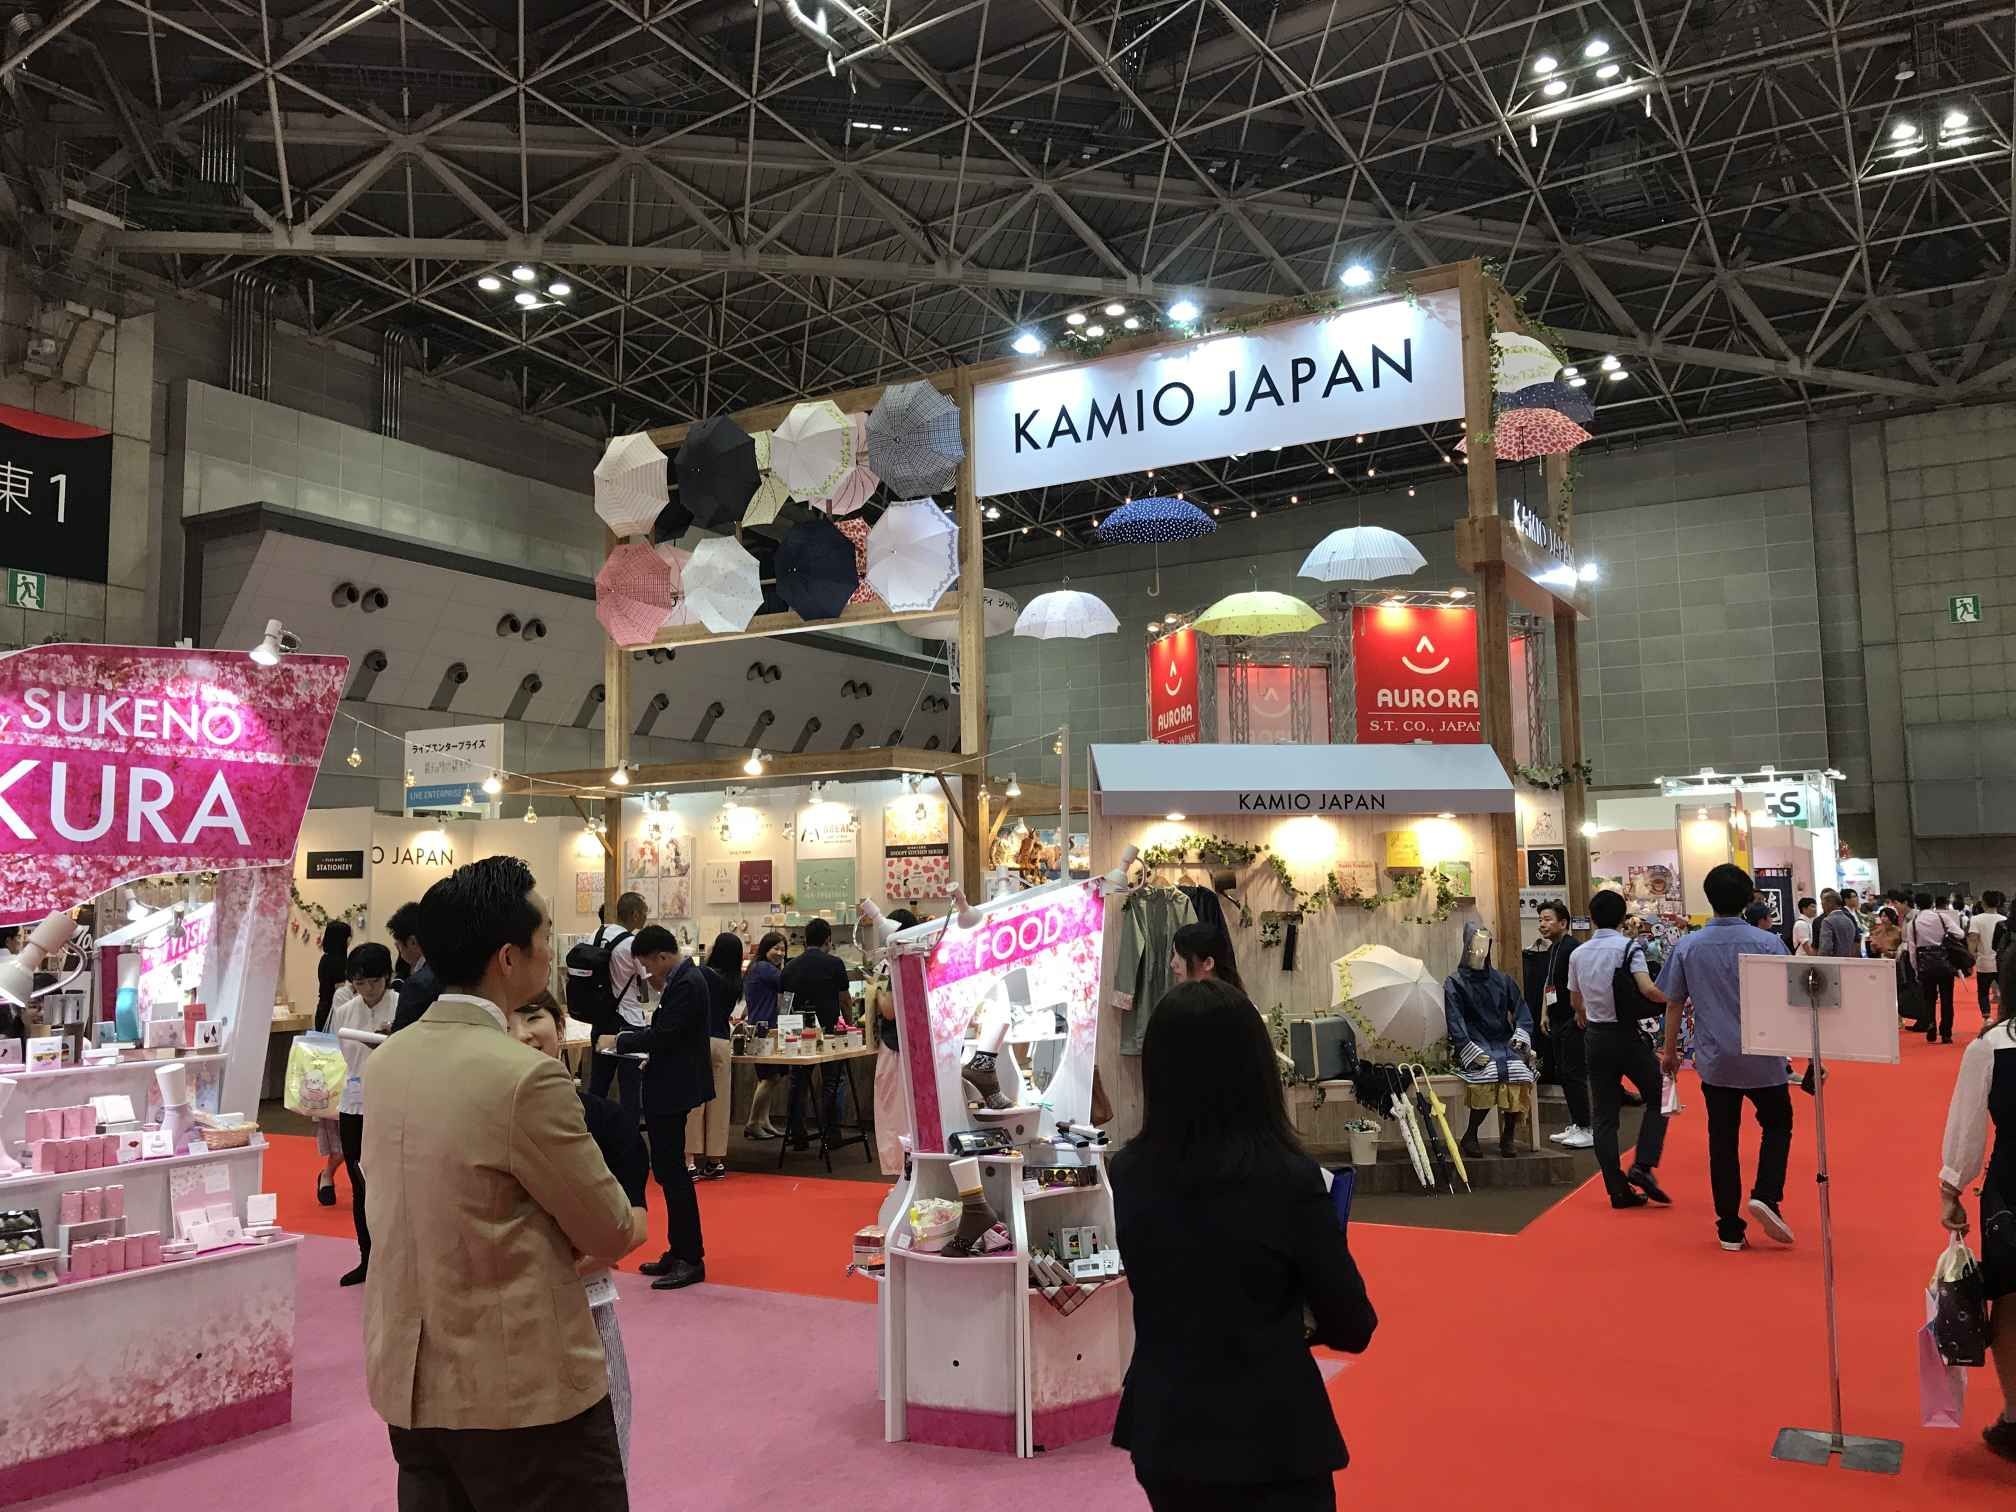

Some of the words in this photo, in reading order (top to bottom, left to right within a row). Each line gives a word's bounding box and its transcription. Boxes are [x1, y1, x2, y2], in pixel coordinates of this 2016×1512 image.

[1014, 381, 1194, 454] KAMIO
[1219, 338, 1413, 416] JAPAN
[1513, 499, 1547, 548] KAMIO
[1377, 688, 1479, 708] AURORA
[22, 687, 242, 745] SUKENO
[1157, 704, 1192, 731] AURORA
[1369, 720, 1398, 732] S.T.
[1403, 720, 1434, 733] CO.,
[0, 759, 251, 847] KURA
[1239, 793, 1311, 810] KAMIO
[1319, 793, 1385, 810] JAPAN
[316, 863, 353, 872] STATIONERY
[392, 847, 454, 865] JAPAN
[975, 911, 1063, 969] FOOD
